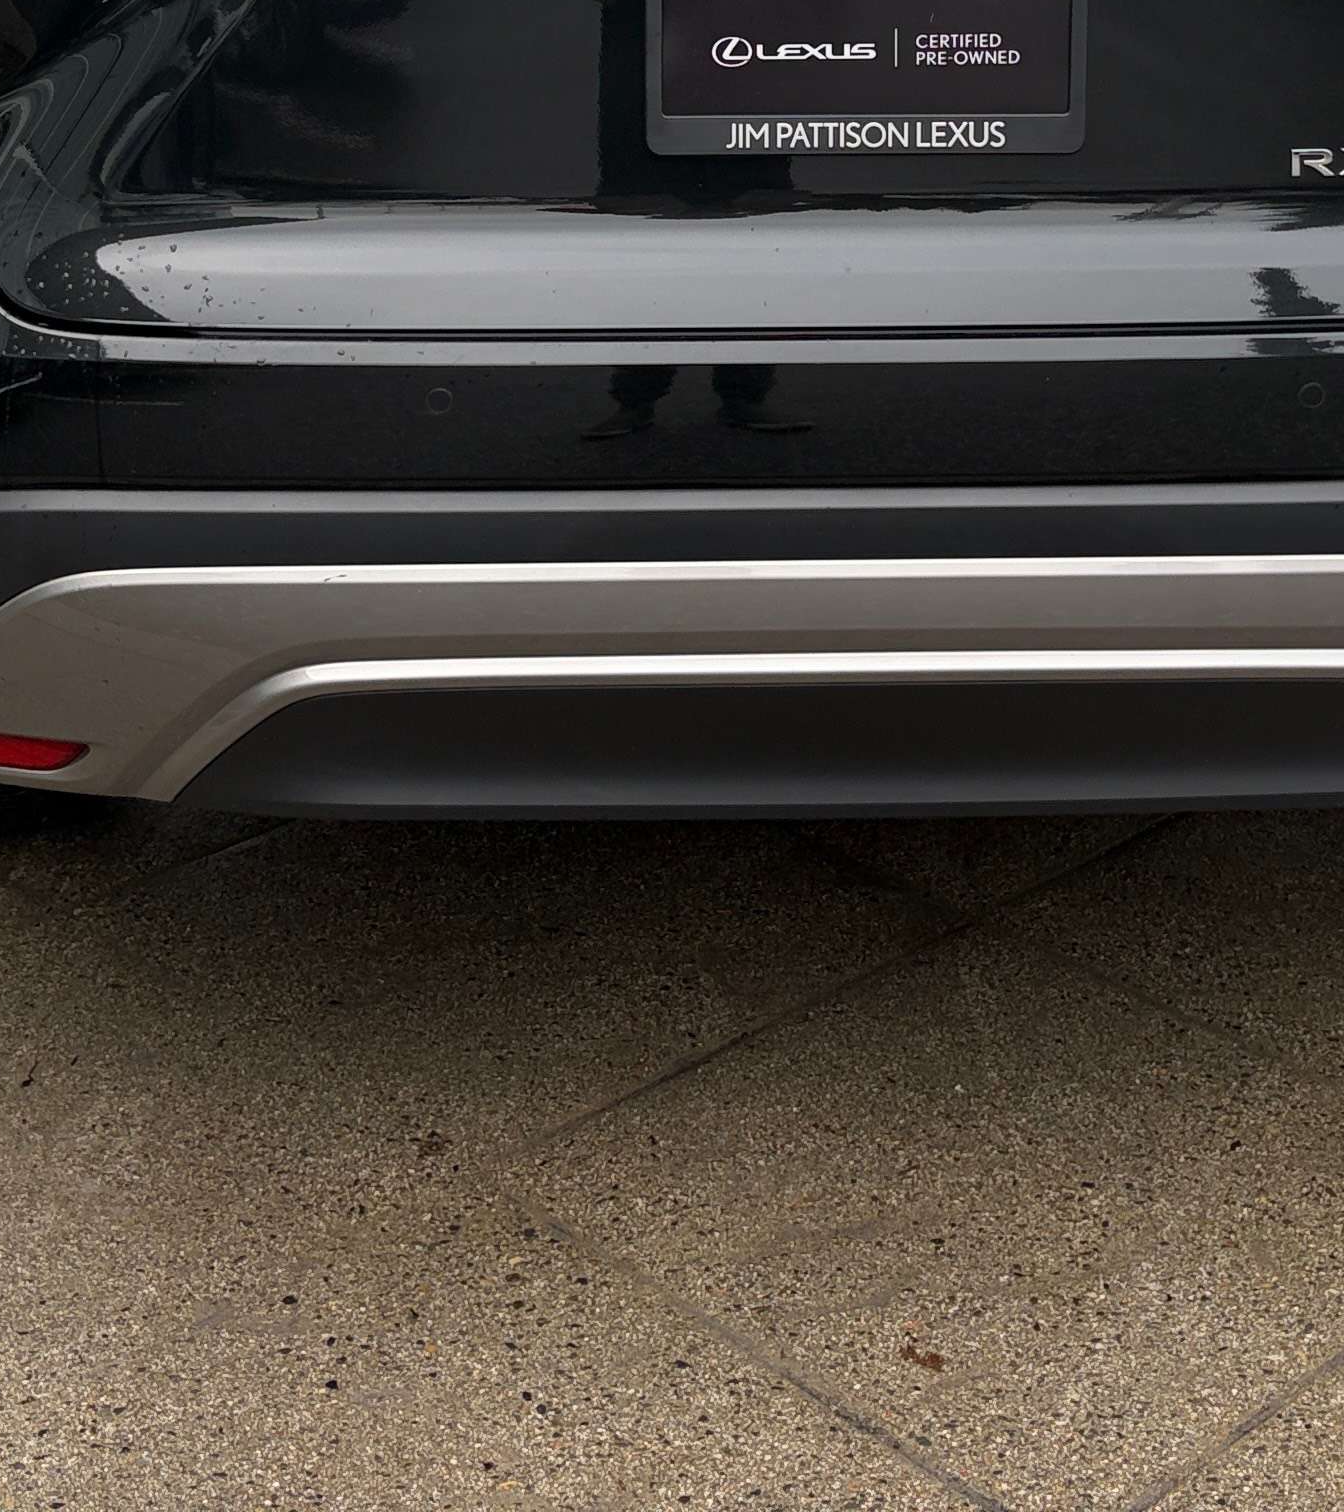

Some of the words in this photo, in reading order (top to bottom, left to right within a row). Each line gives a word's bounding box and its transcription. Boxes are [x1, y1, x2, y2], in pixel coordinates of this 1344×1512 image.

[915, 33, 1002, 49] CERTIFIED
[757, 42, 877, 60] LEXUS
[915, 50, 1021, 67] PRE-OWNED
[726, 123, 770, 149] JIM
[776, 122, 909, 149] PATTISON
[916, 121, 1006, 148] LEXUS
